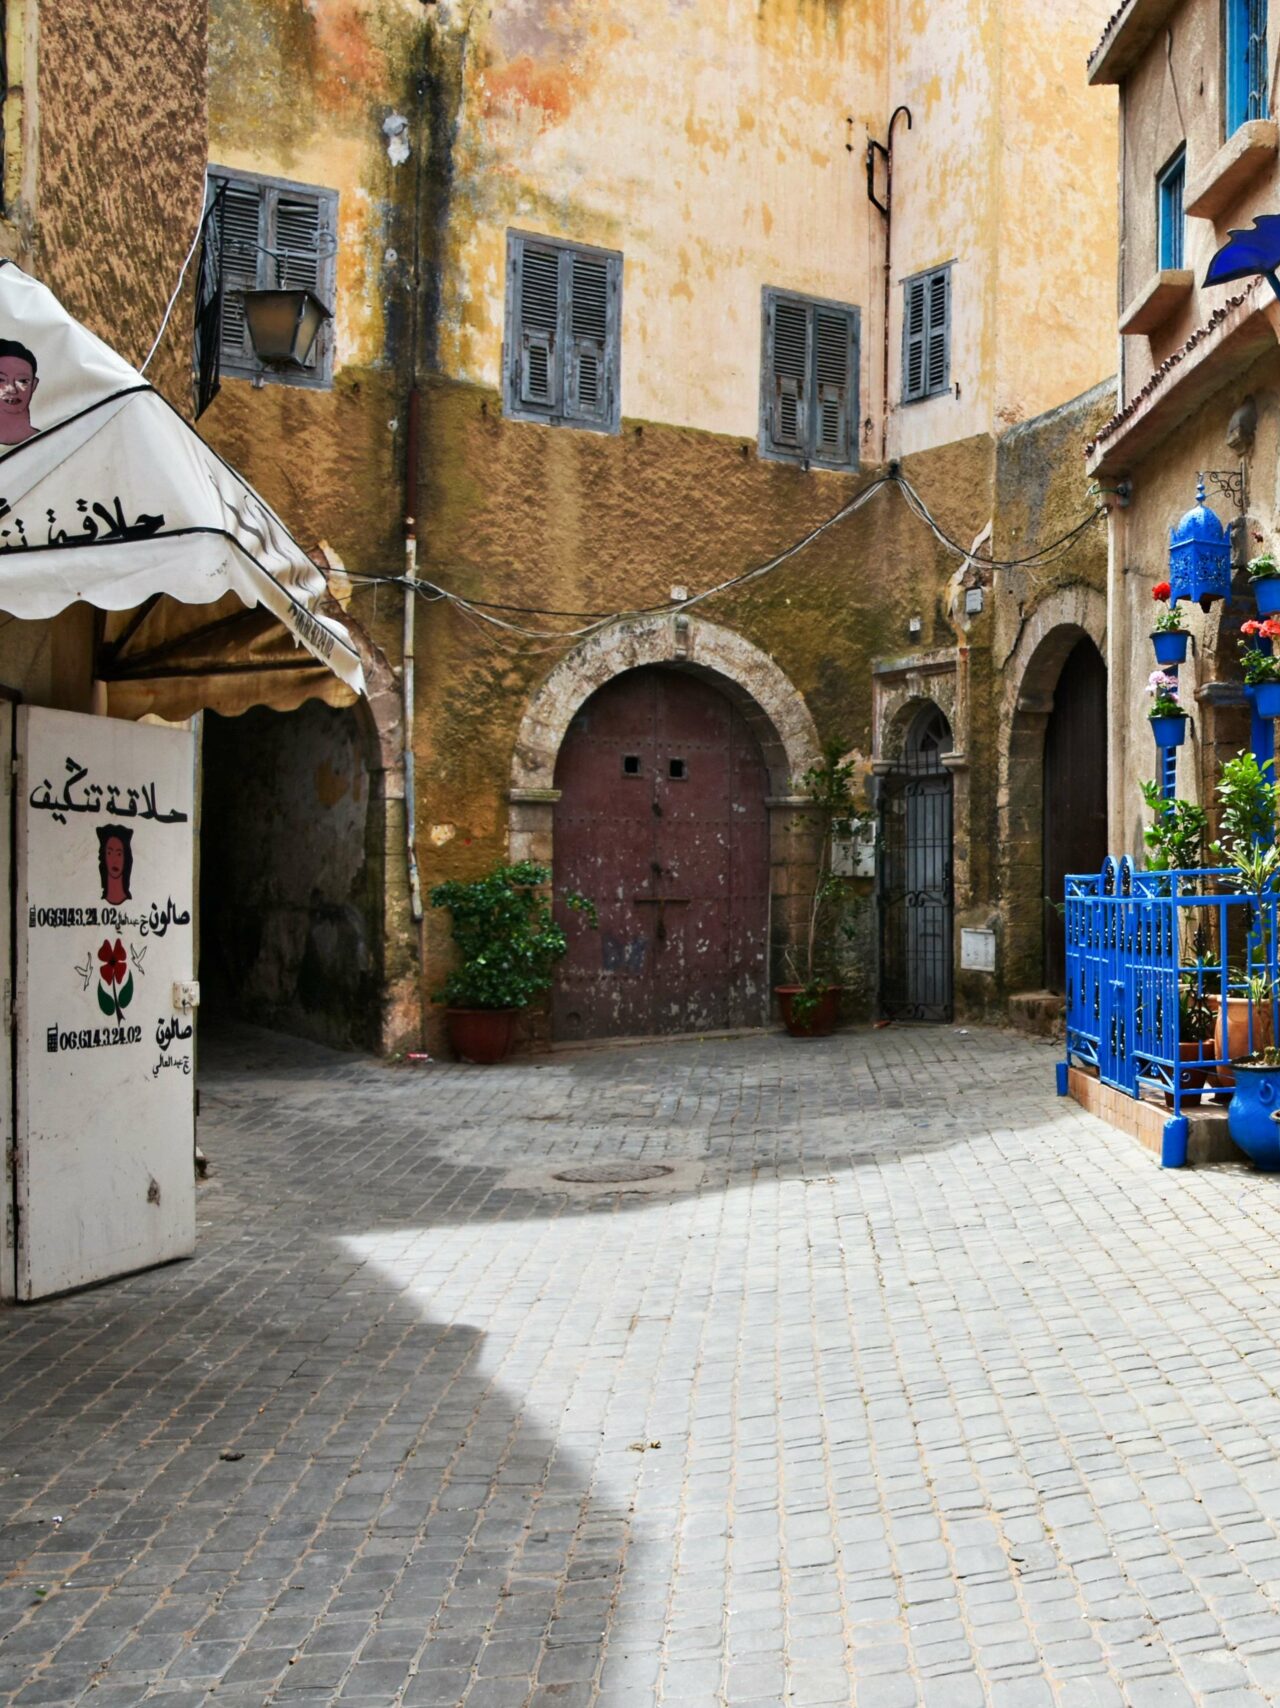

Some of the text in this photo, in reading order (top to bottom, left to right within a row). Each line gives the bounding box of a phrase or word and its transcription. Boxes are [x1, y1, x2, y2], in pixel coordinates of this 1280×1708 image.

[47, 496, 166, 543] حلاقة
[105, 781, 188, 824] حلاقة
[148, 894, 190, 938] صالون
[155, 1014, 193, 1051] صالون
